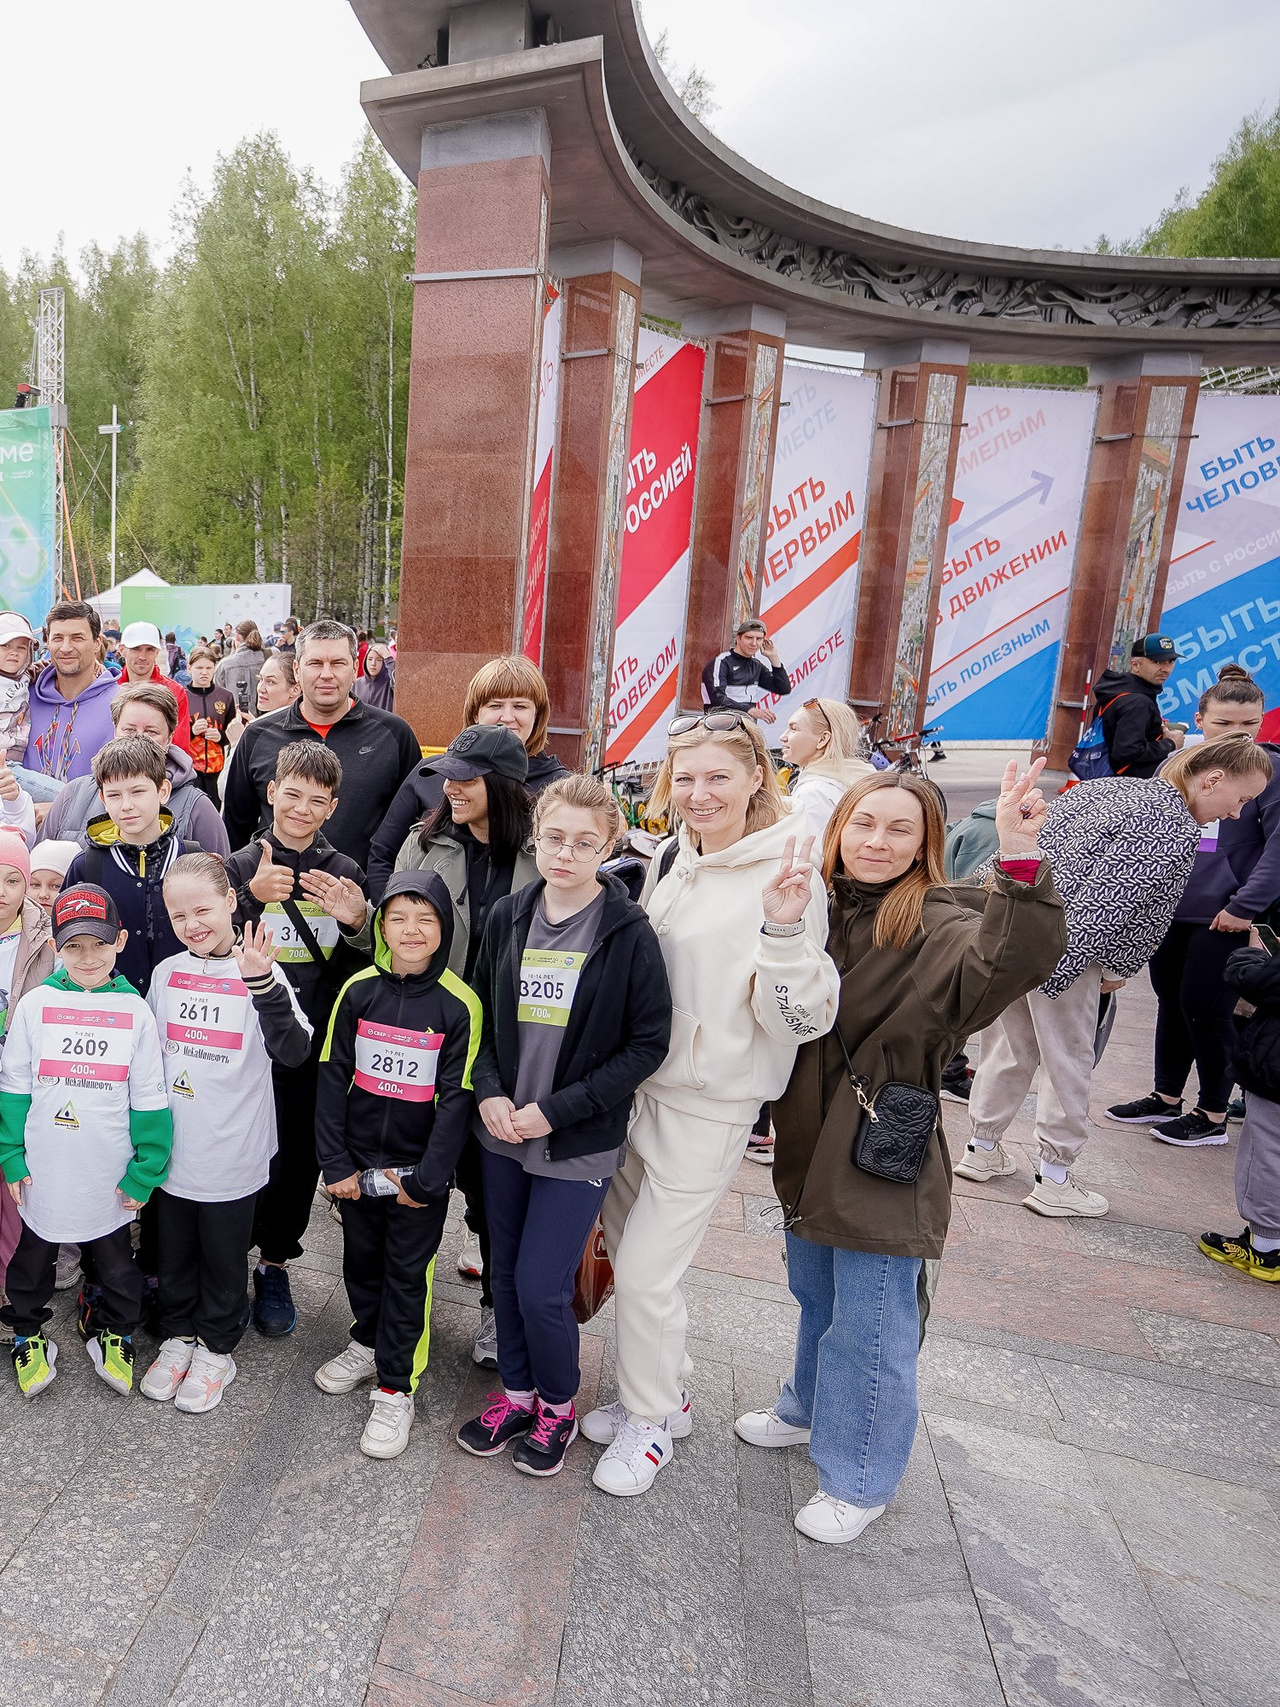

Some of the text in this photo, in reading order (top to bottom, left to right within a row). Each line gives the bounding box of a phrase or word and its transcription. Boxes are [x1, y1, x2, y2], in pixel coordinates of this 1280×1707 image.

[960, 404, 1011, 446] ЫТЬ
[956, 409, 1047, 481] МЕЛЫМ
[1200, 435, 1276, 483] БЫТЬ
[624, 442, 693, 534] ОССИЕЙ
[1186, 454, 1280, 514] ЧЕЛОВ
[941, 537, 1001, 586] БЫТЬ
[1223, 528, 1280, 567] РОССИ
[949, 530, 1068, 620] ДВИЖЕНИИ
[1174, 596, 1280, 665] БЫТЬ
[960, 619, 1051, 684] ПОЛЕЗНЫМ
[280, 926, 320, 942] 311
[288, 949, 309, 958] 700м
[179, 1002, 220, 1024] 2611
[530, 1006, 551, 1019] 700м
[61, 1037, 109, 1057] 2609
[184, 1028, 208, 1041] 400м
[70, 1064, 96, 1075] 400м
[371, 1053, 419, 1078] 2812
[378, 1081, 403, 1095] 400м
